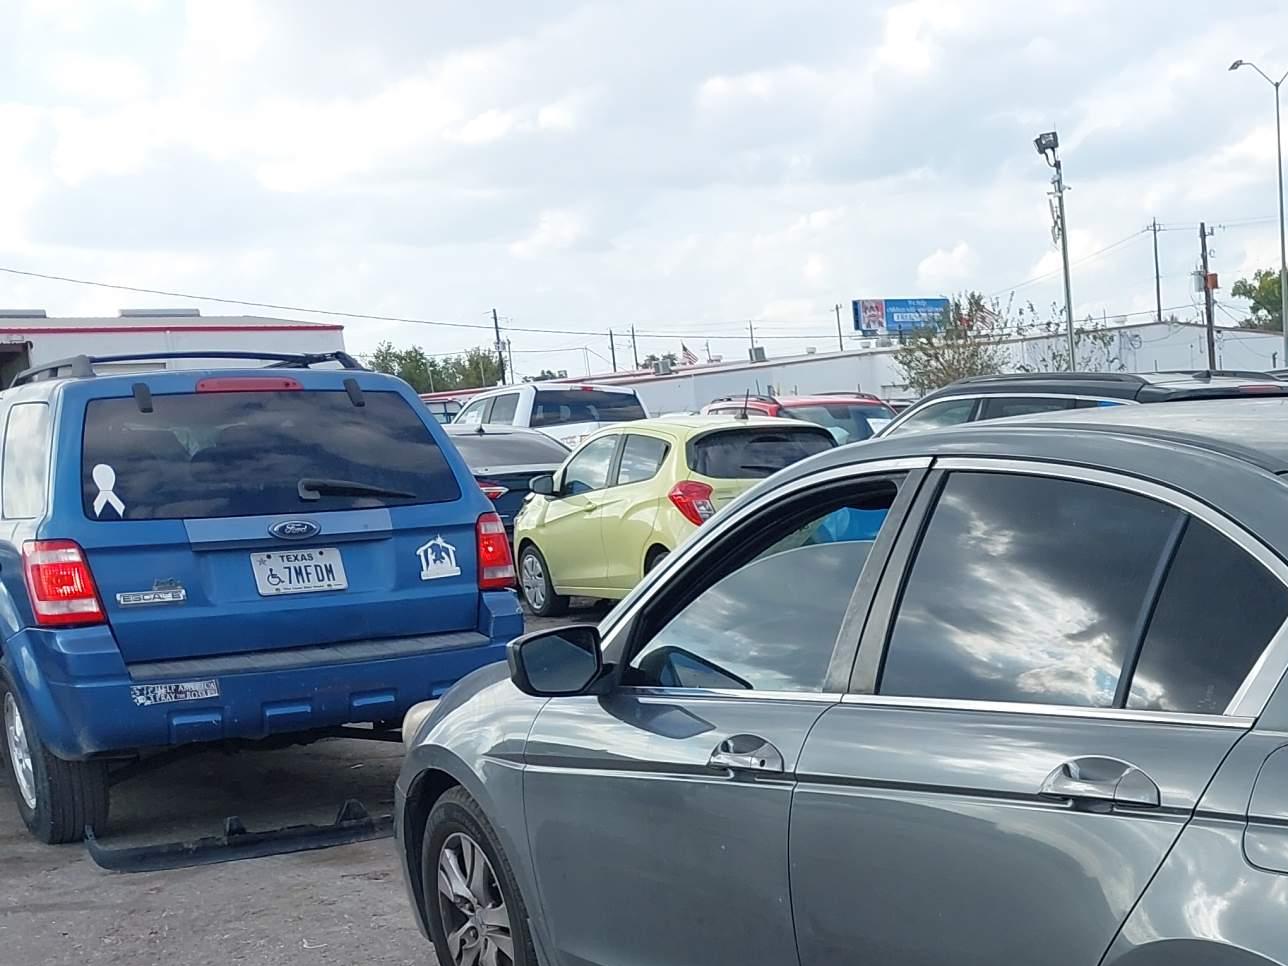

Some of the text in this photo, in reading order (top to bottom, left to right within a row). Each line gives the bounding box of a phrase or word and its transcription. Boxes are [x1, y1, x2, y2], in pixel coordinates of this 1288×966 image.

[284, 523, 308, 534] Ford
[279, 553, 314, 563] TEXAS
[283, 563, 336, 585] 7MFDM
